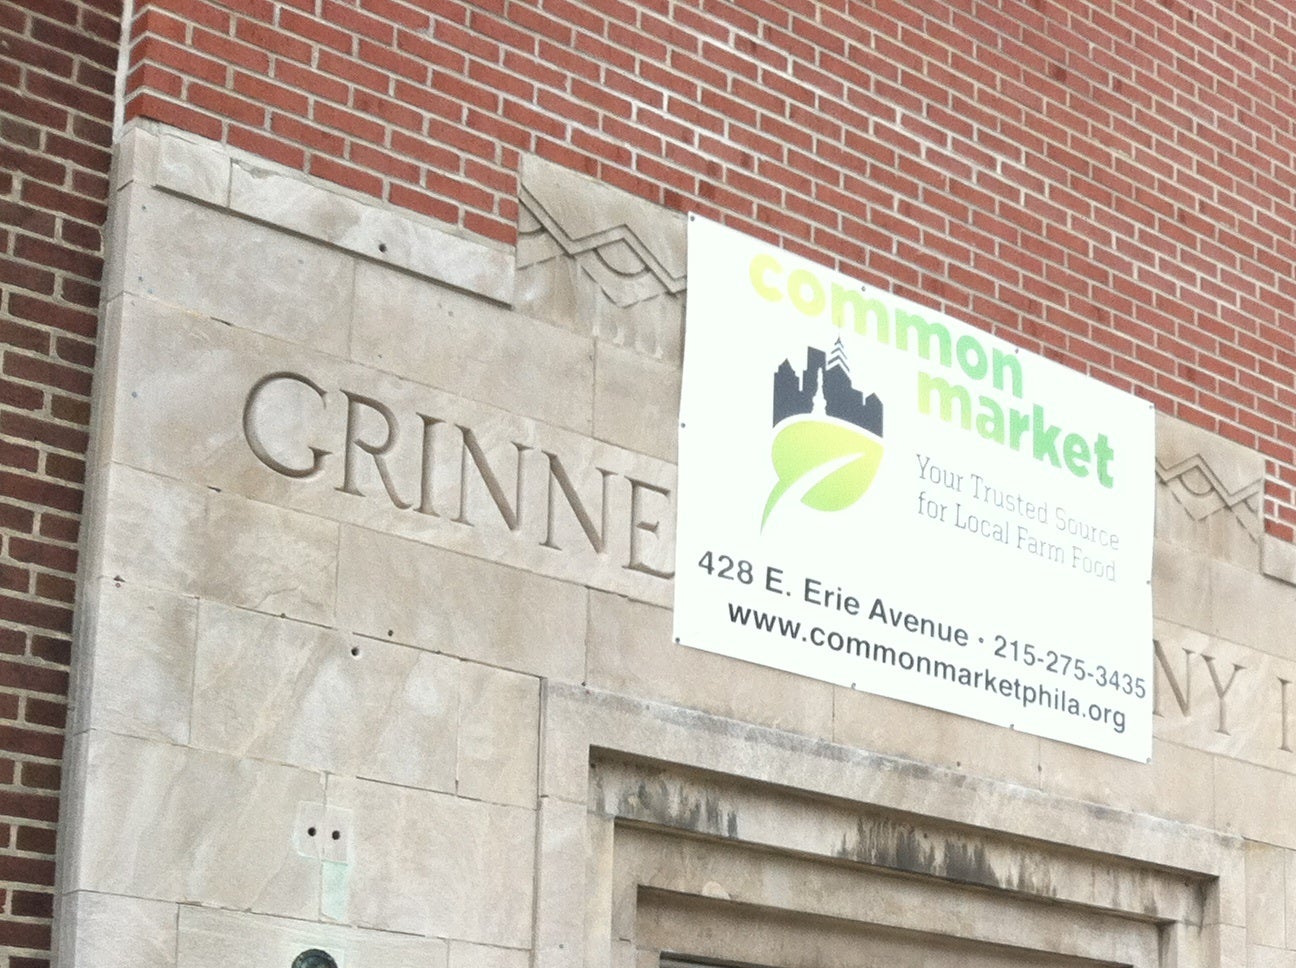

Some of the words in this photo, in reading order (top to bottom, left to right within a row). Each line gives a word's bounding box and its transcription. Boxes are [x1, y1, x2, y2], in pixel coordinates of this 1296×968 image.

[749, 253, 1023, 399] common
[243, 371, 675, 580] GRINNE
[918, 370, 1114, 489] market
[916, 453, 964, 492] Your
[970, 473, 1048, 525] Trusted
[1055, 506, 1120, 551] Source
[918, 491, 947, 522] for
[954, 502, 1009, 545] Local
[1017, 525, 1065, 564] Farm
[1072, 545, 1116, 582] Food
[698, 550, 754, 585] 428
[765, 566, 791, 597] E.
[804, 578, 860, 616] Erie
[868, 599, 969, 647] Avenue
[994, 634, 1146, 699] 215-275-3435
[728, 602, 1126, 733] www.commonmarketphila.org
